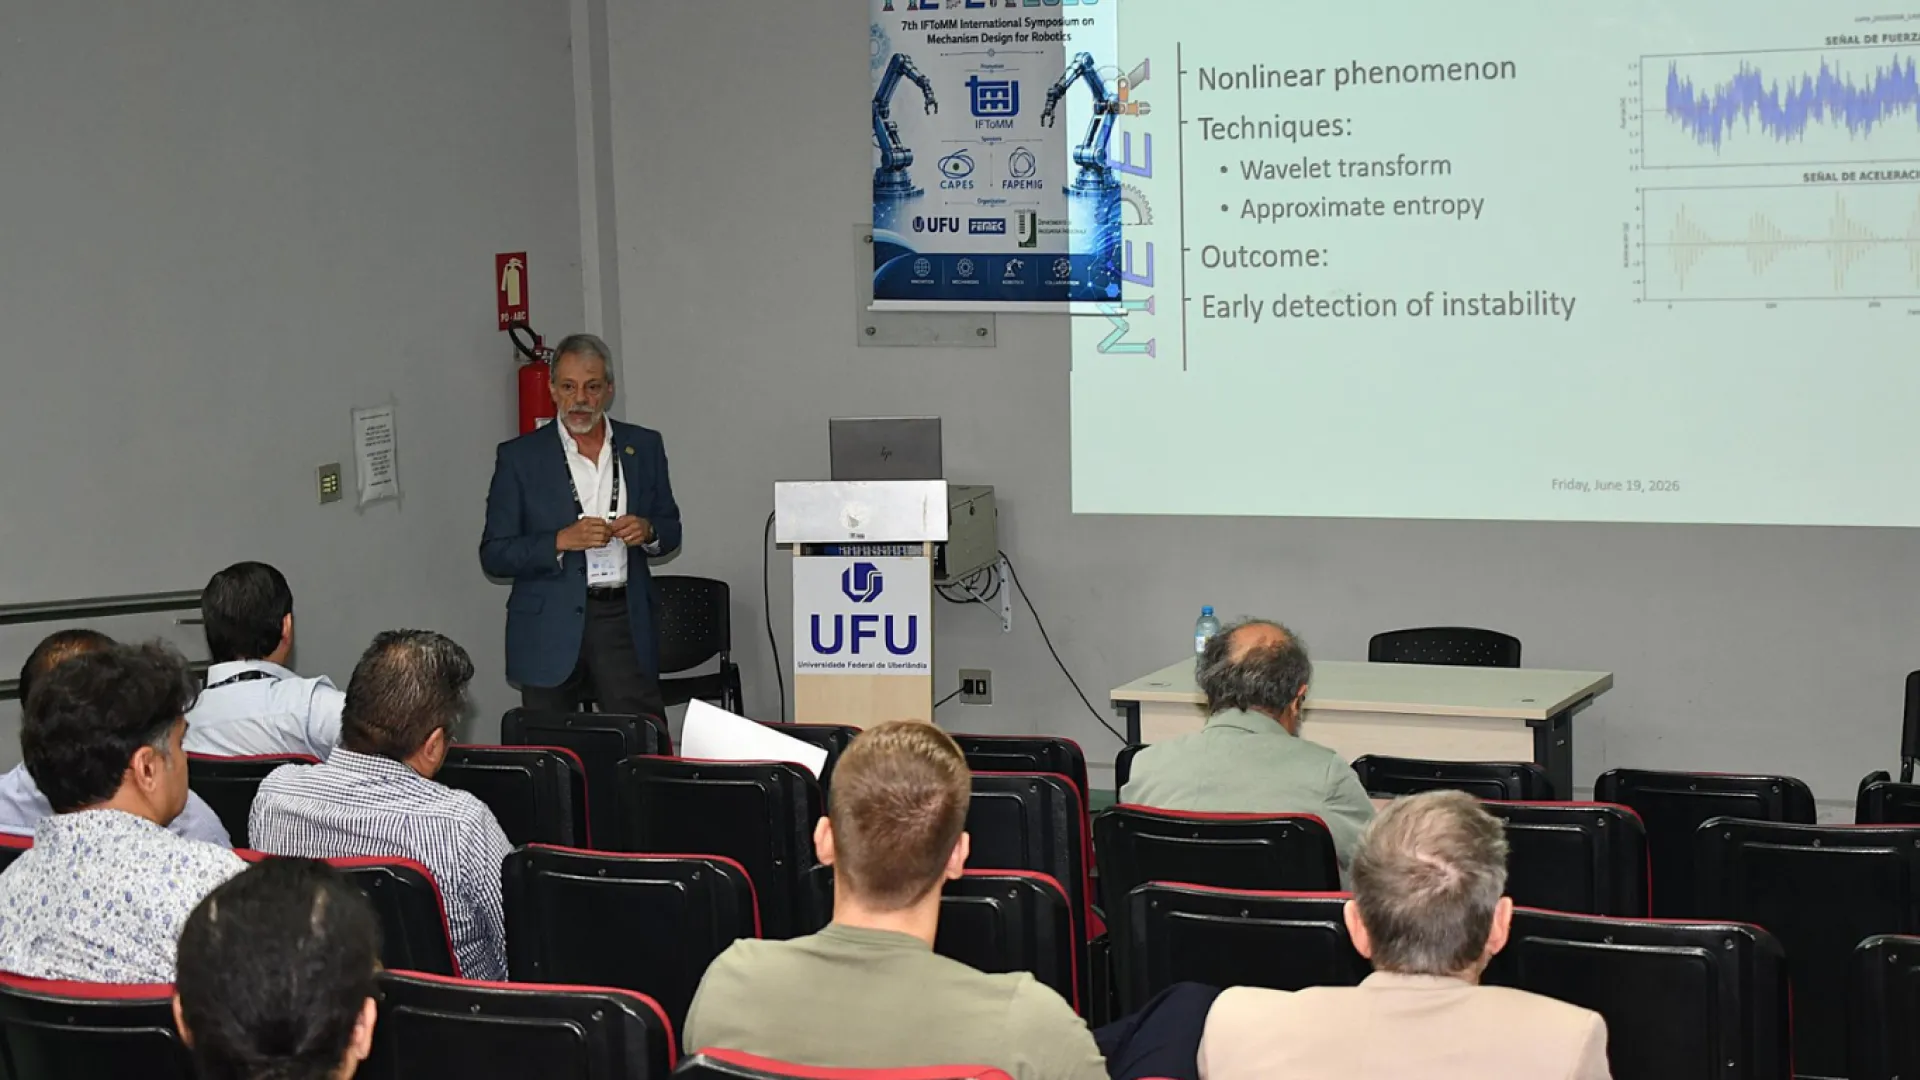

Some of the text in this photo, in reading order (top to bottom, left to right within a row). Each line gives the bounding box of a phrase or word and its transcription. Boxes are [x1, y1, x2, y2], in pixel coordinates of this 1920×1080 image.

[901, 16, 1095, 31] 7th IFToMM International Symposium on
[926, 31, 1072, 45] Mechanism Design for Robotics
[1864, 34, 1878, 44] DE
[1198, 56, 1517, 91] Nonlinear phenomenon
[975, 120, 1013, 129] IFToMM
[1197, 115, 1352, 143] Techniques:
[1239, 154, 1452, 180] Wavelet transform
[1841, 172, 1856, 181] DE
[940, 180, 974, 189] CAPES
[1002, 180, 1043, 189] FAPEMIG
[1240, 194, 1485, 224] Approximate entropy
[927, 217, 960, 232] UFU
[971, 220, 1004, 232] FEMEC
[1201, 244, 1328, 268] Outcome:
[1203, 291, 1576, 322] Early detection of instability
[1552, 478, 1680, 493] Friday, June 19, 2026
[811, 614, 917, 654] UFU
[798, 660, 928, 669] Universidade Federal de Uberlândia
